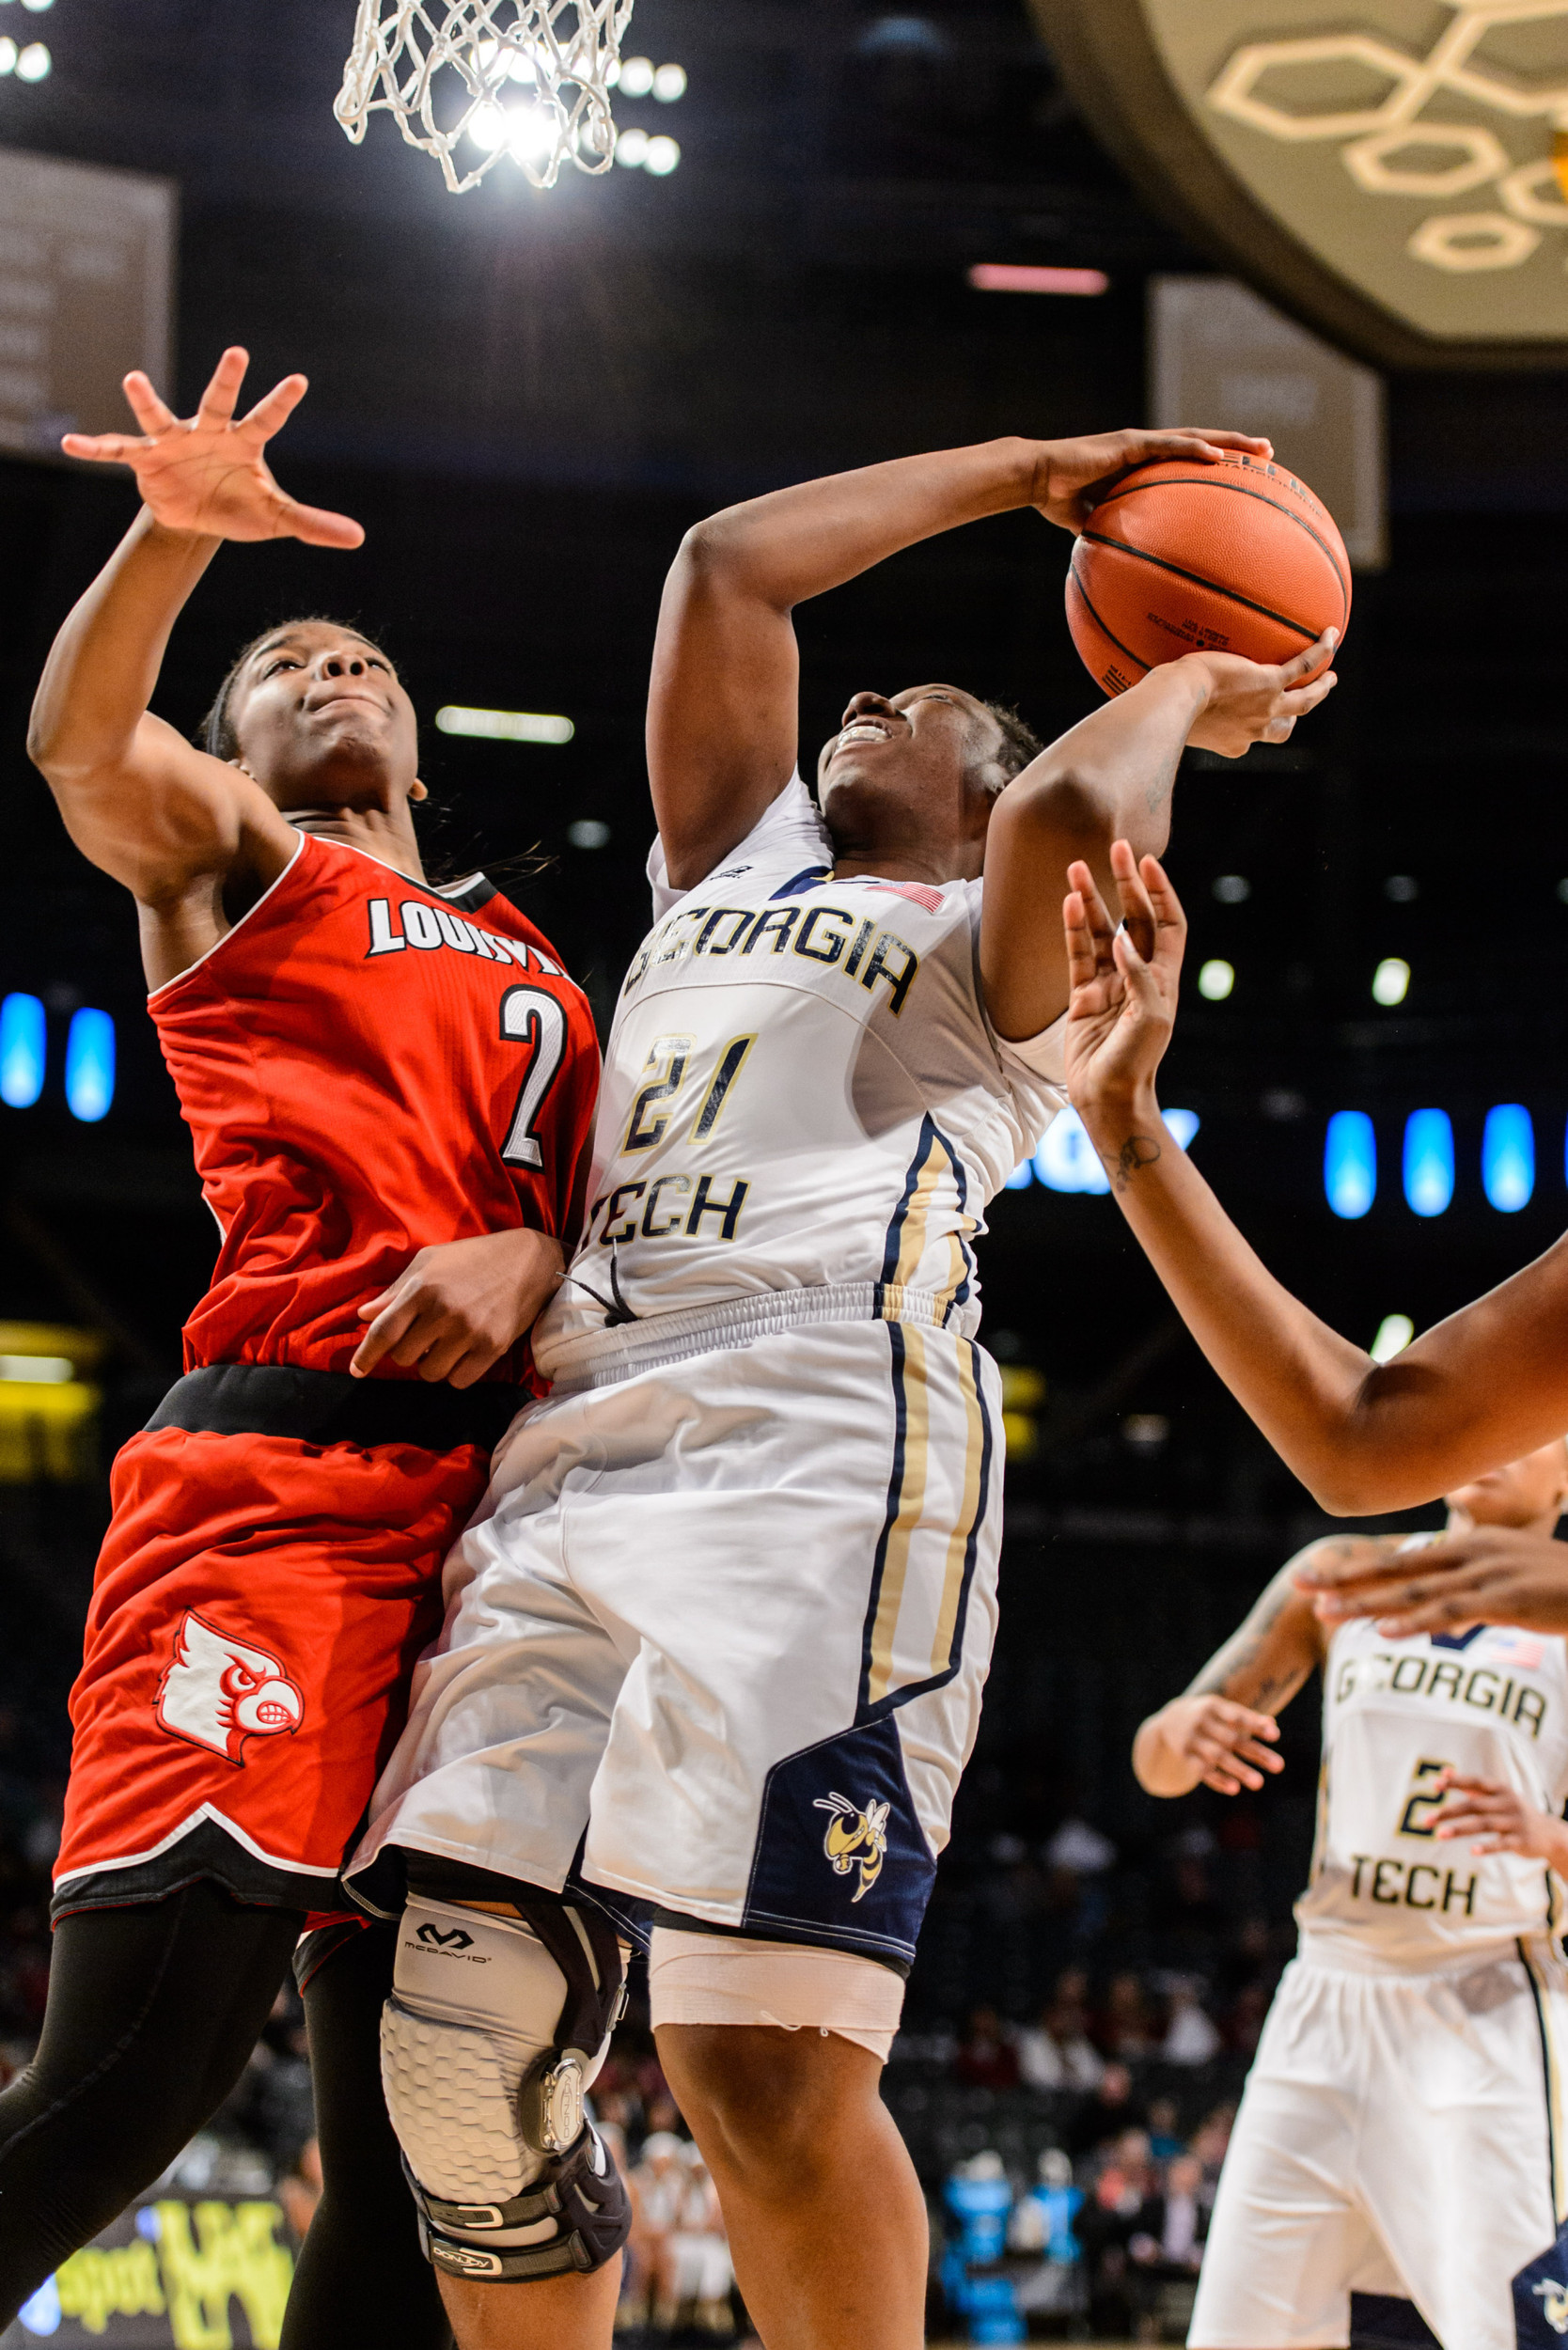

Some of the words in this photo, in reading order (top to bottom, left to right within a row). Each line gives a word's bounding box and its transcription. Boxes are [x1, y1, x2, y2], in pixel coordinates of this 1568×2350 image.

[364, 898, 575, 981] LOUISVI
[498, 983, 568, 1174] 2
[620, 1032, 759, 1158] 21
[1351, 1854, 1480, 1917] TECH
